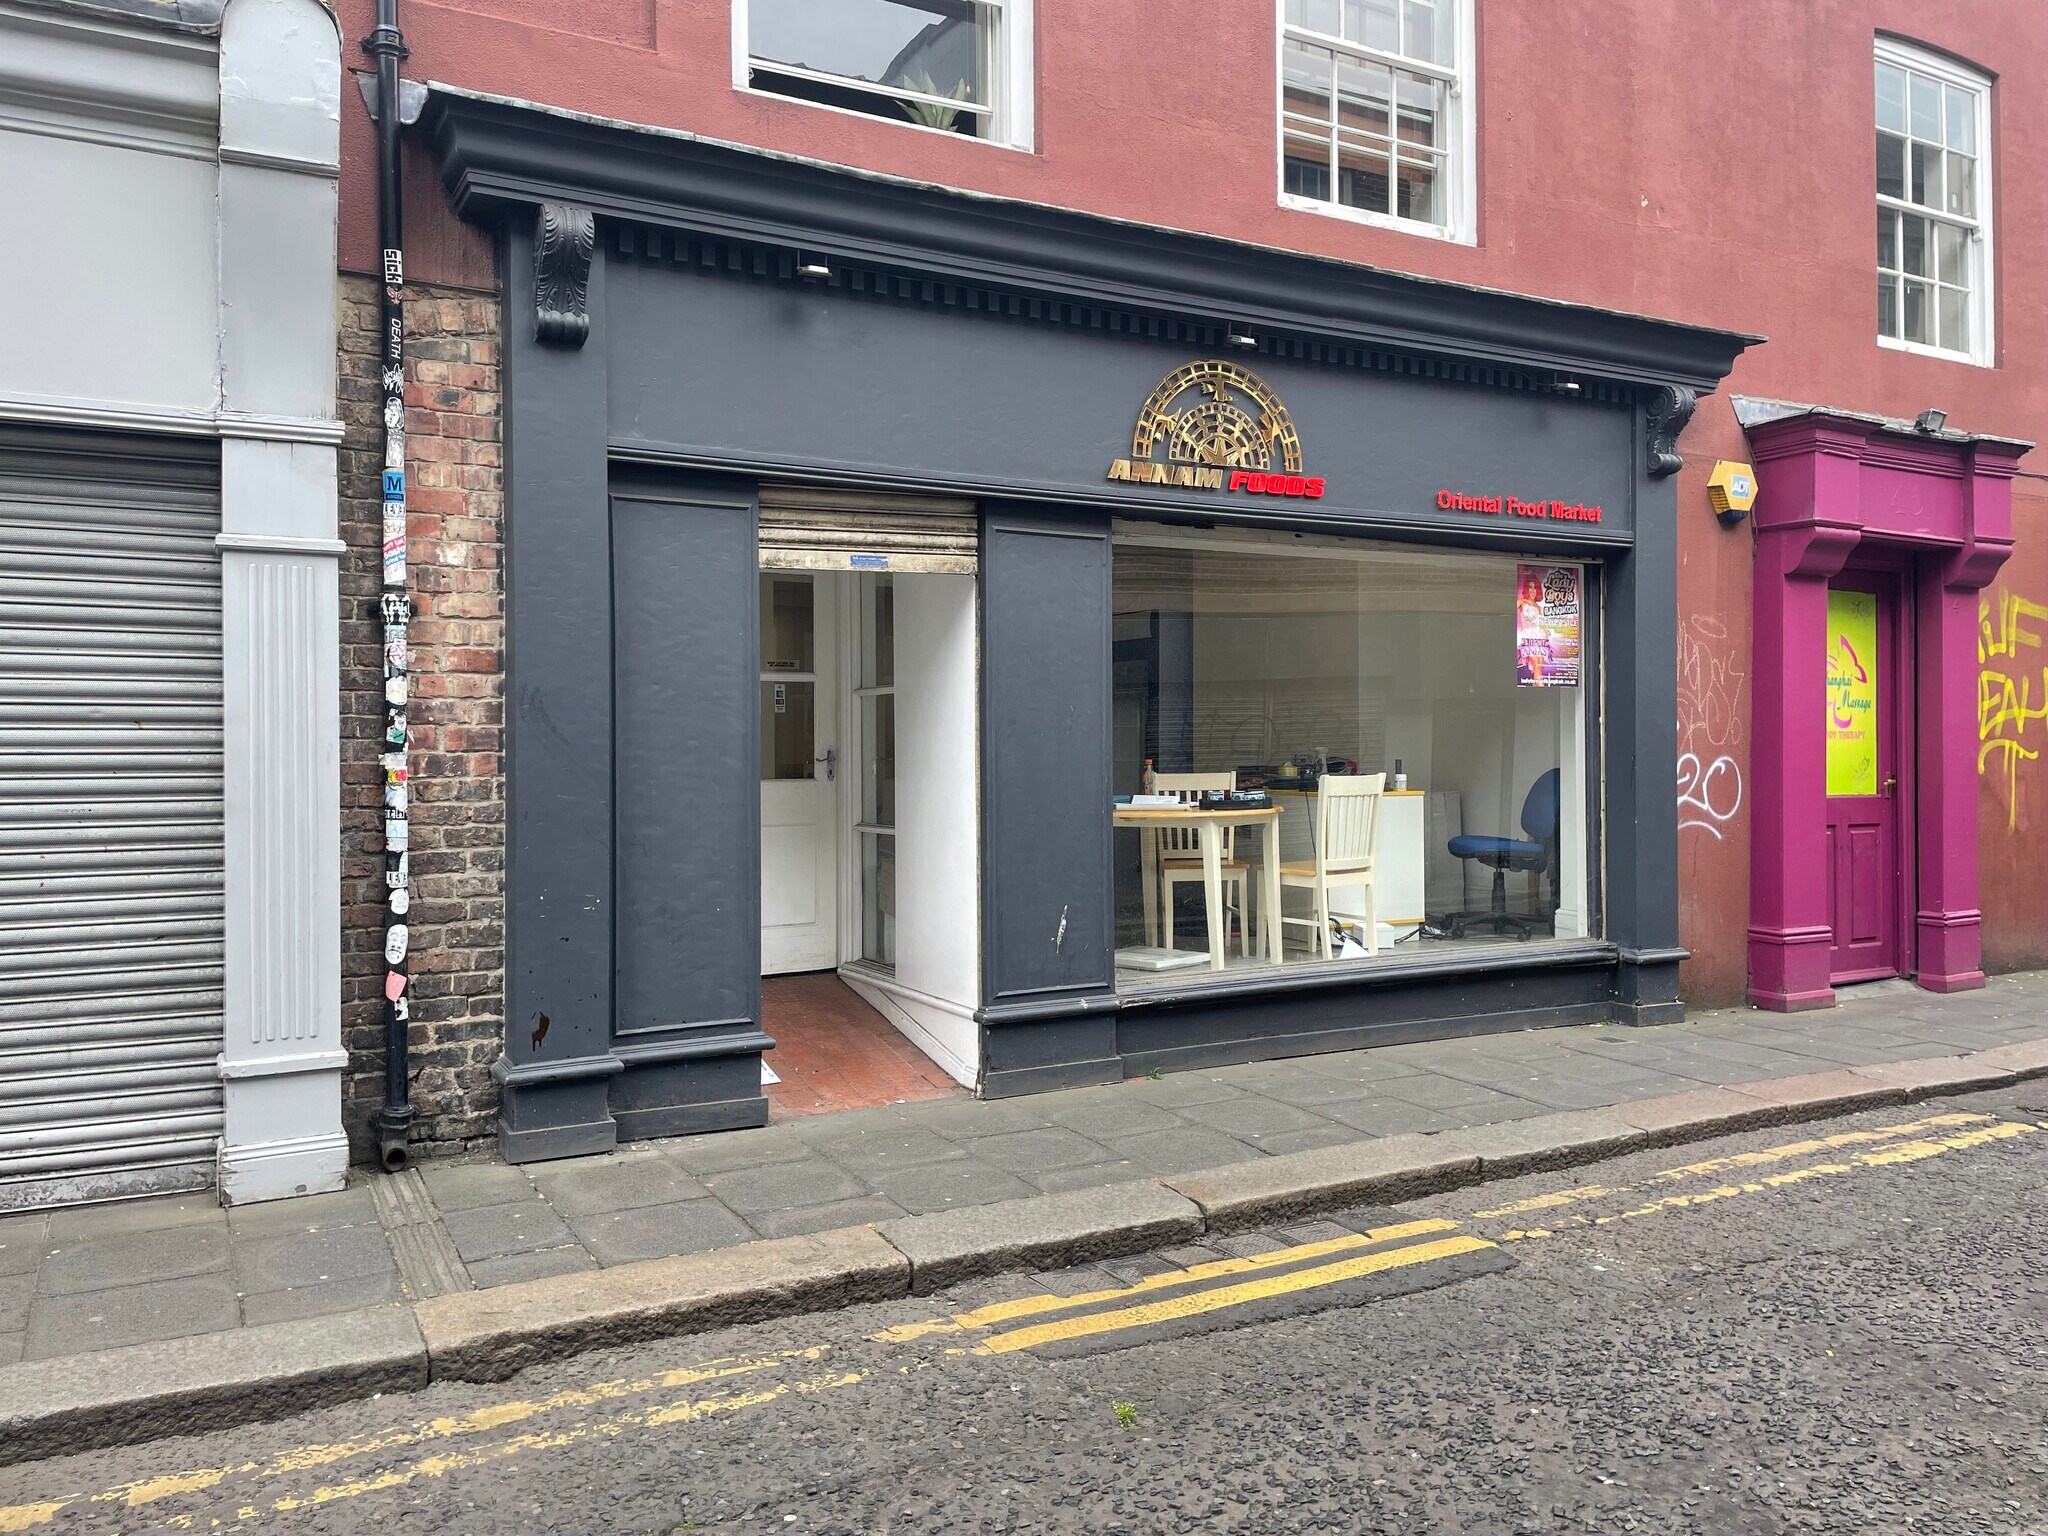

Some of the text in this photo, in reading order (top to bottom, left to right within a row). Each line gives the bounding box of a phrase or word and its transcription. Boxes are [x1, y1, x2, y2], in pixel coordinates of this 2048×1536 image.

[391, 317, 402, 360] DEATH
[1106, 459, 1326, 498] ANNAM FOODS
[1732, 480, 1750, 494] ADT
[1437, 489, 1602, 522] Oriental Food Market
[1545, 573, 1575, 592] Lady
[1545, 589, 1574, 605] Boys
[1544, 604, 1578, 616] BANGKOK
[1837, 689, 1871, 713] Massage
[1838, 731, 1865, 739] THERAPY
